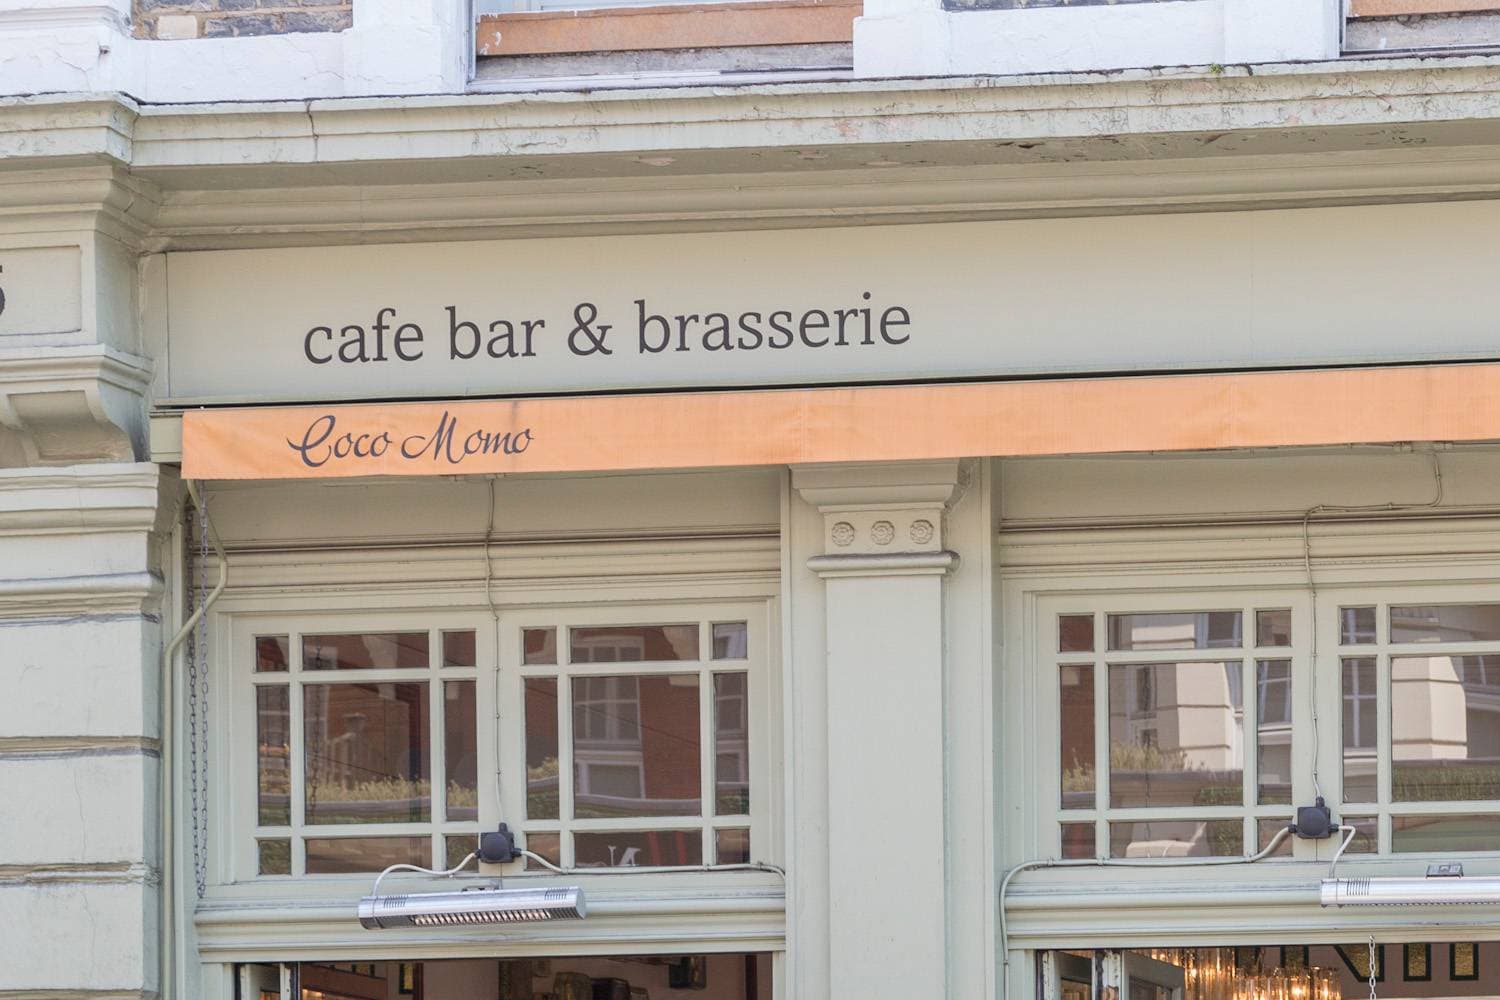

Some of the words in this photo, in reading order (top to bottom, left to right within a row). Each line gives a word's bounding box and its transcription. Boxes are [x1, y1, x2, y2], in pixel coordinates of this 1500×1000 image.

[304, 308, 424, 365] cafe
[447, 306, 545, 359] bar
[567, 303, 613, 356] &
[636, 292, 912, 353] brasserie
[287, 414, 392, 468] Coco
[401, 410, 534, 465] Momo
